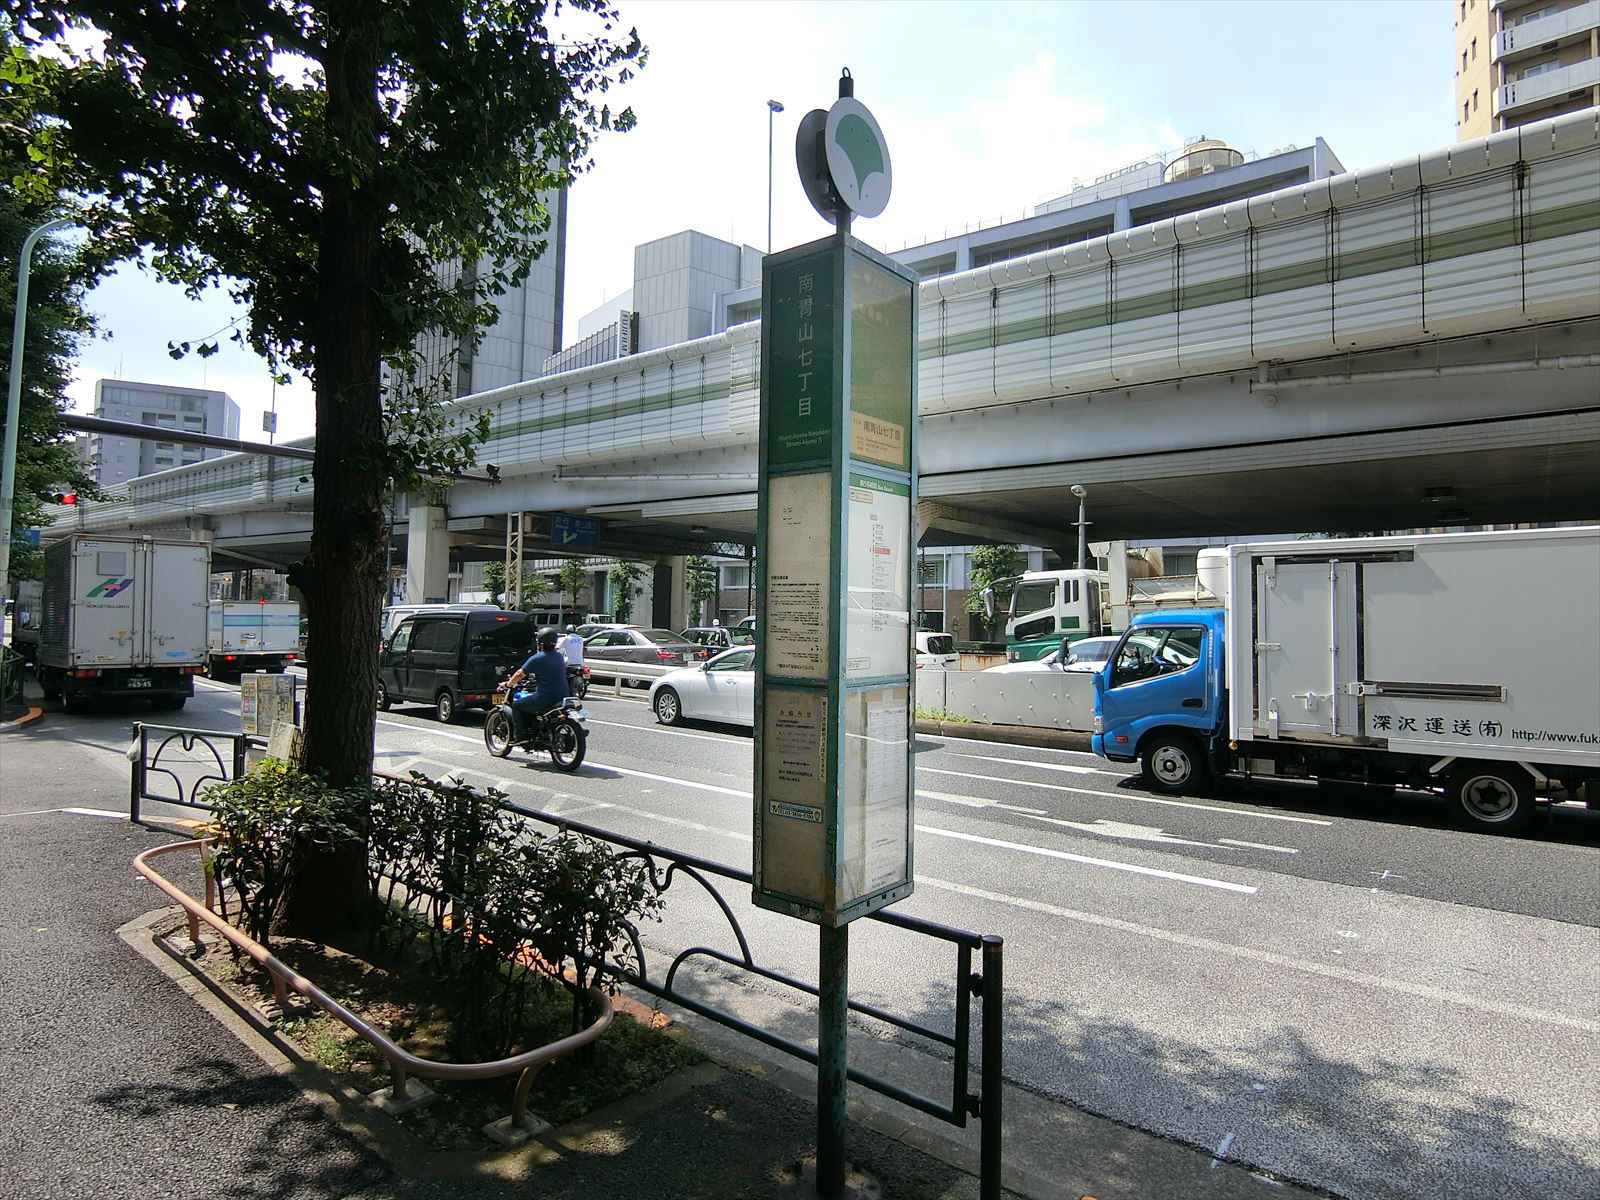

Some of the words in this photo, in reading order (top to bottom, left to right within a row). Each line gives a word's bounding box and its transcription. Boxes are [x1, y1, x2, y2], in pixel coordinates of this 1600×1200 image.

[621, 314, 629, 352] FUJIFILM
[798, 273, 814, 416] 南青山七丁目
[864, 421, 901, 440] 南青山七丁目
[1512, 729, 1600, 744] http://www.fuk
